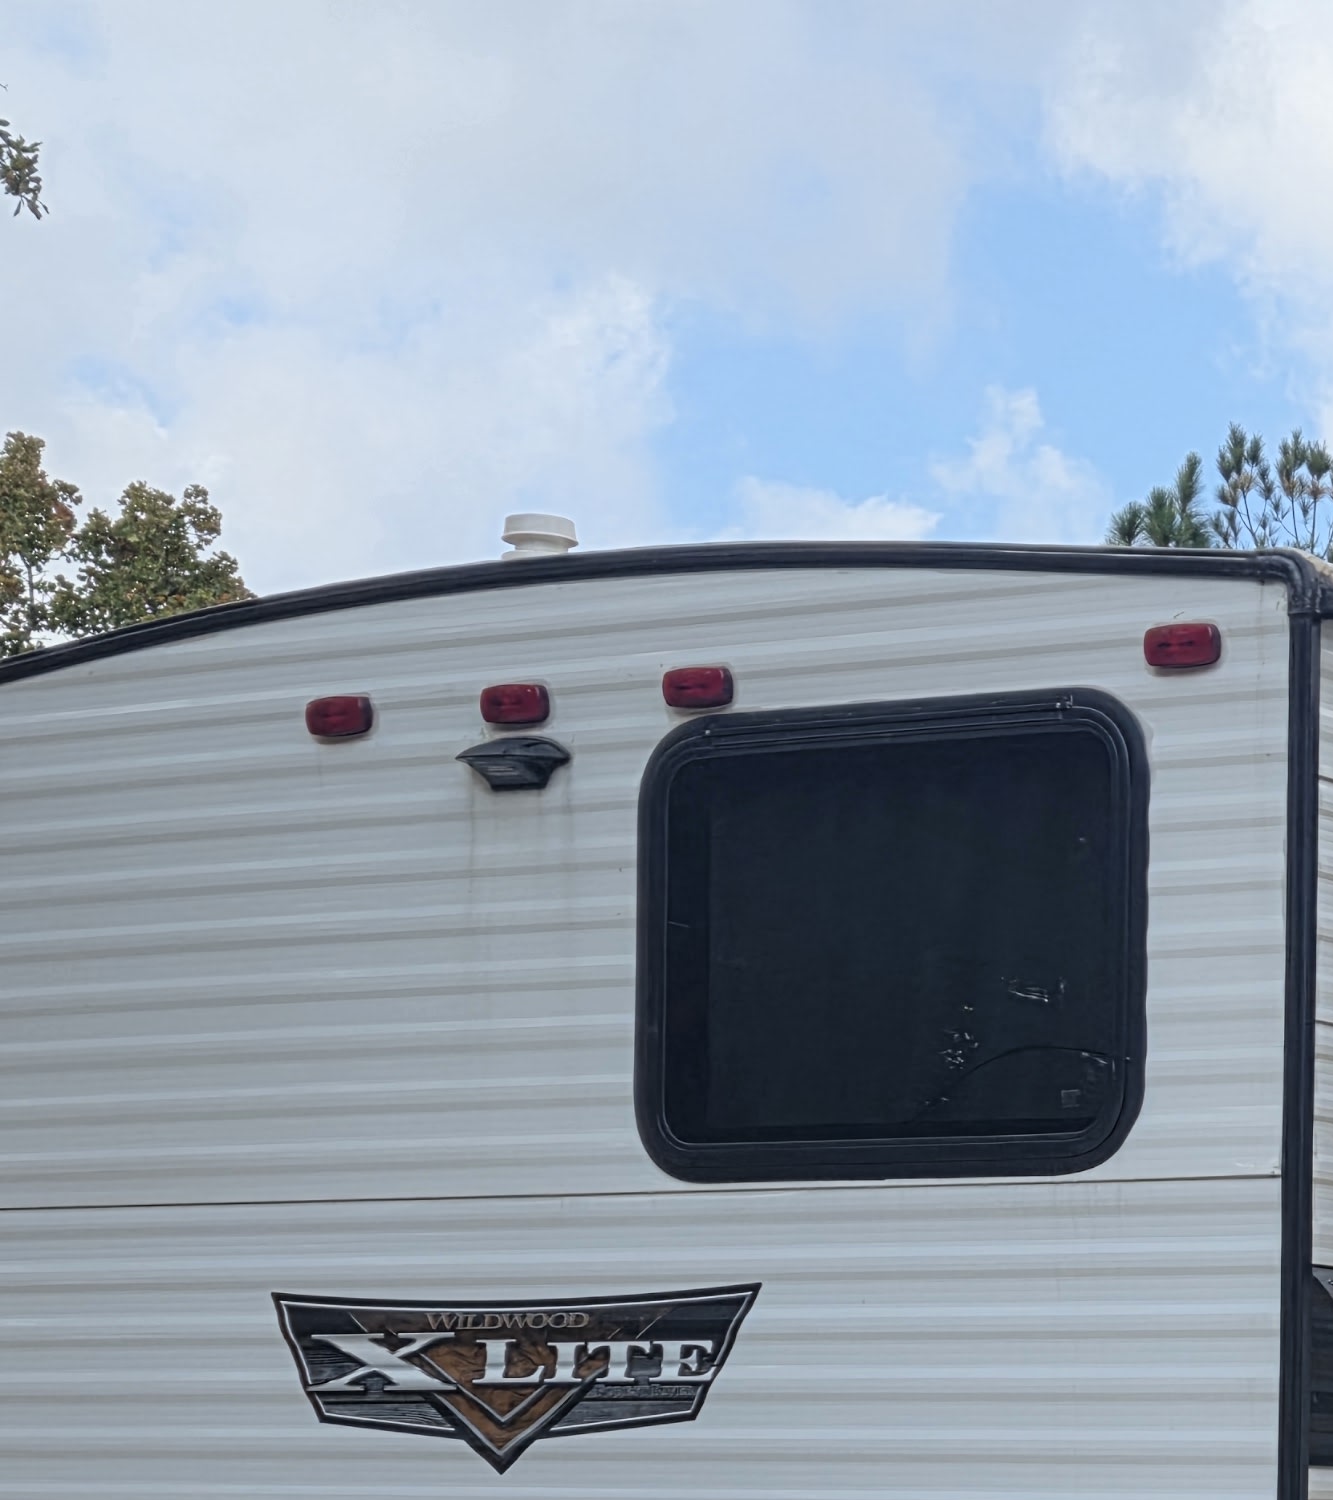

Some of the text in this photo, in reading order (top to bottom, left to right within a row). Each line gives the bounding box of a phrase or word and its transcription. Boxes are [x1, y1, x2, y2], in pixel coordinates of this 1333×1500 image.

[425, 1312, 590, 1330] WILDWOOD
[307, 1332, 718, 1392] X LITE
